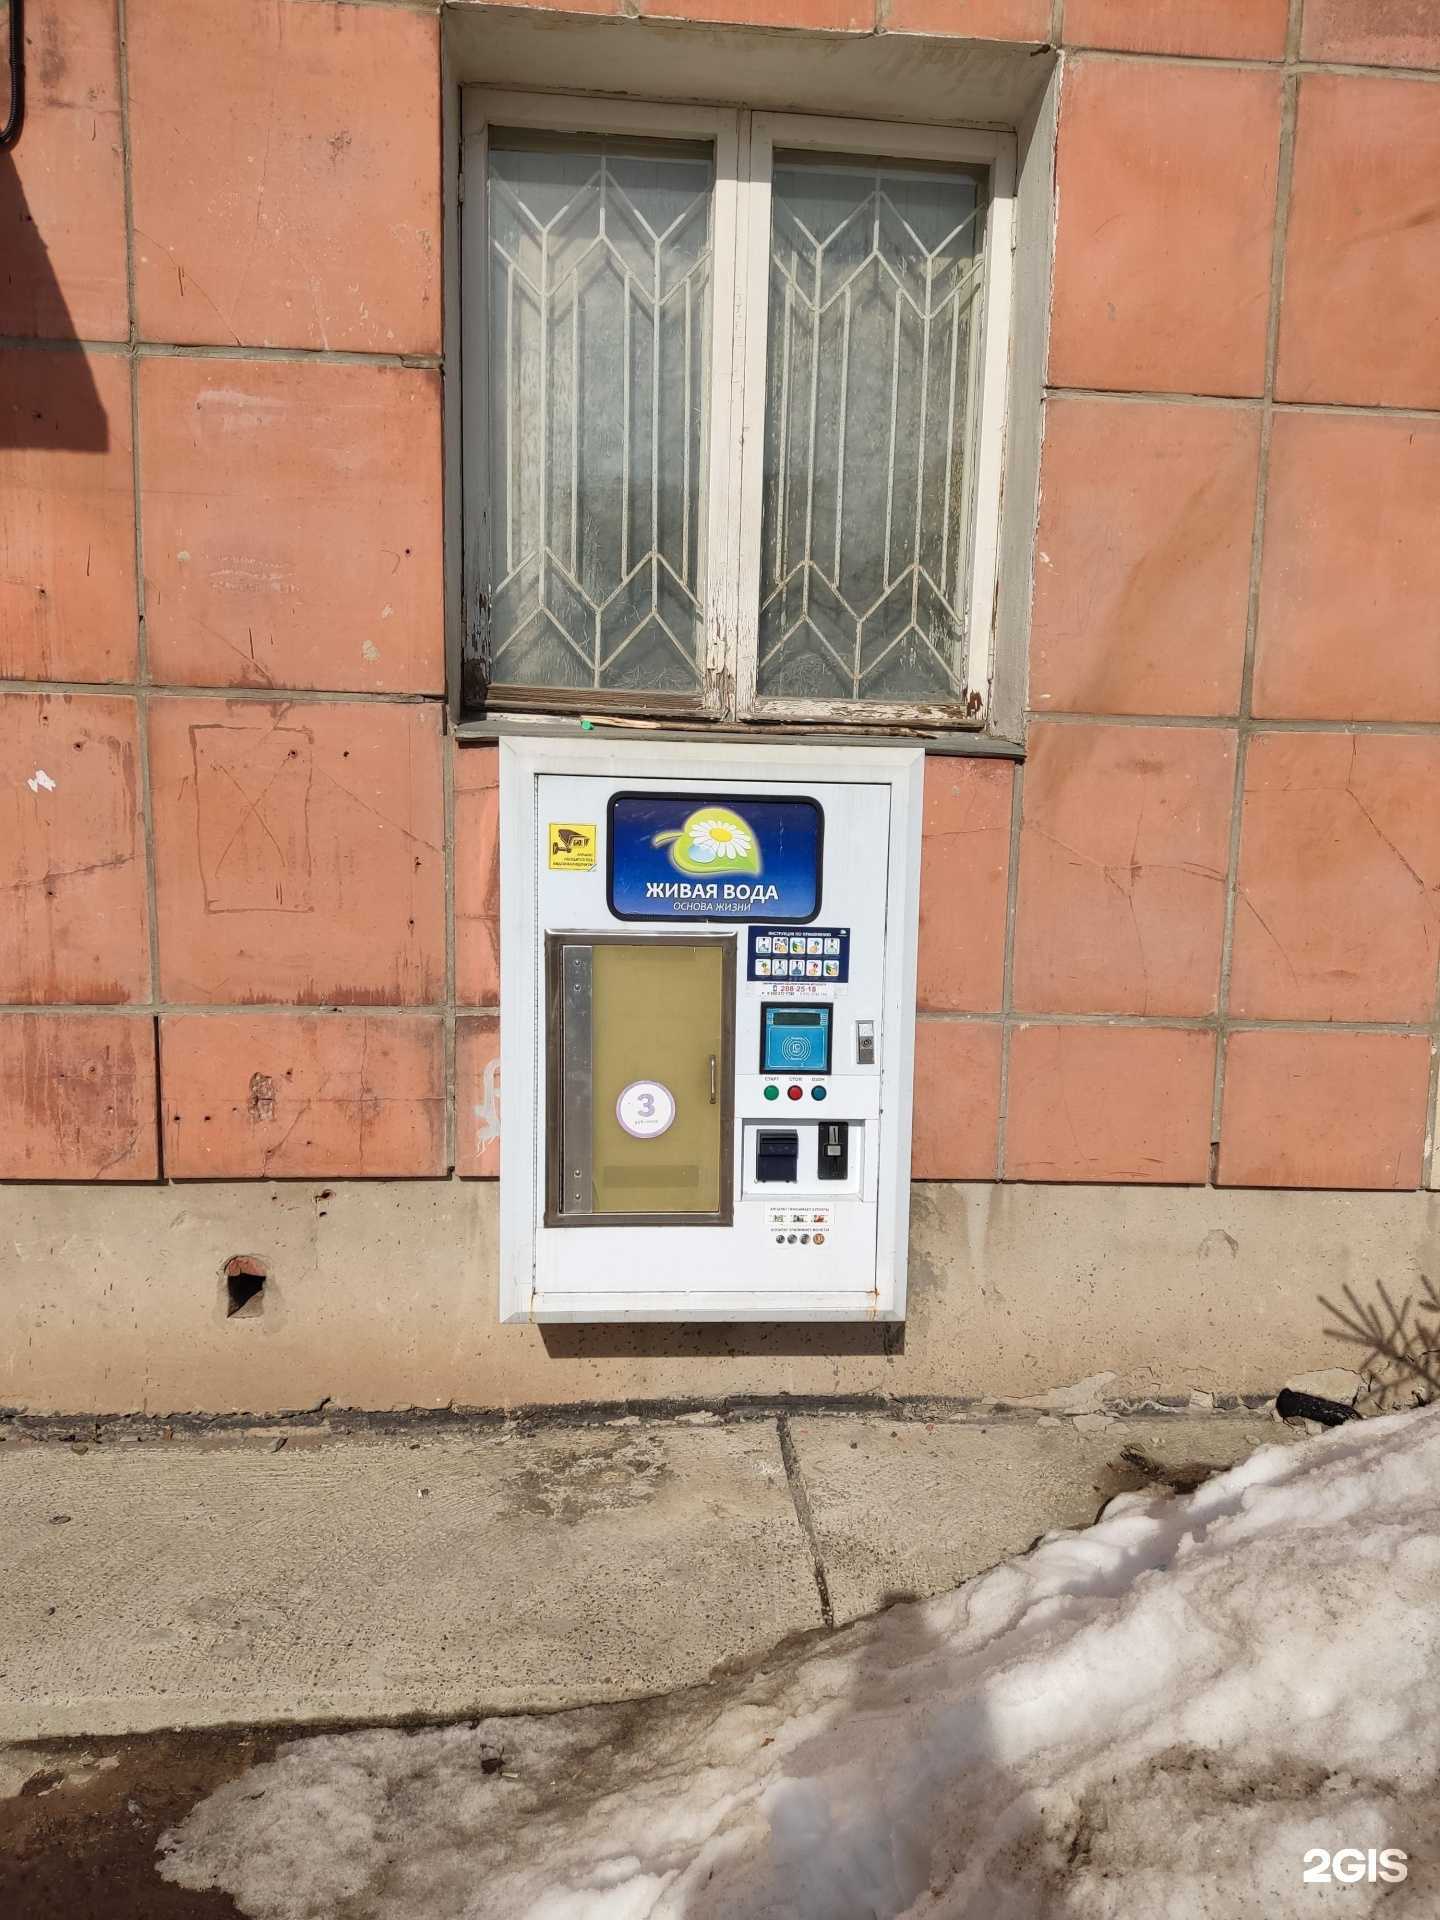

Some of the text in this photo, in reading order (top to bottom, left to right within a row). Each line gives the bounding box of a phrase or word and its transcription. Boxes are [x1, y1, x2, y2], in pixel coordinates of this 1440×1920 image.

[646, 882, 779, 903] ЖИВАЯ ВОДА
[673, 901, 752, 912] ОСНОВА ЖИЗНИ
[637, 1093, 656, 1117] 3
